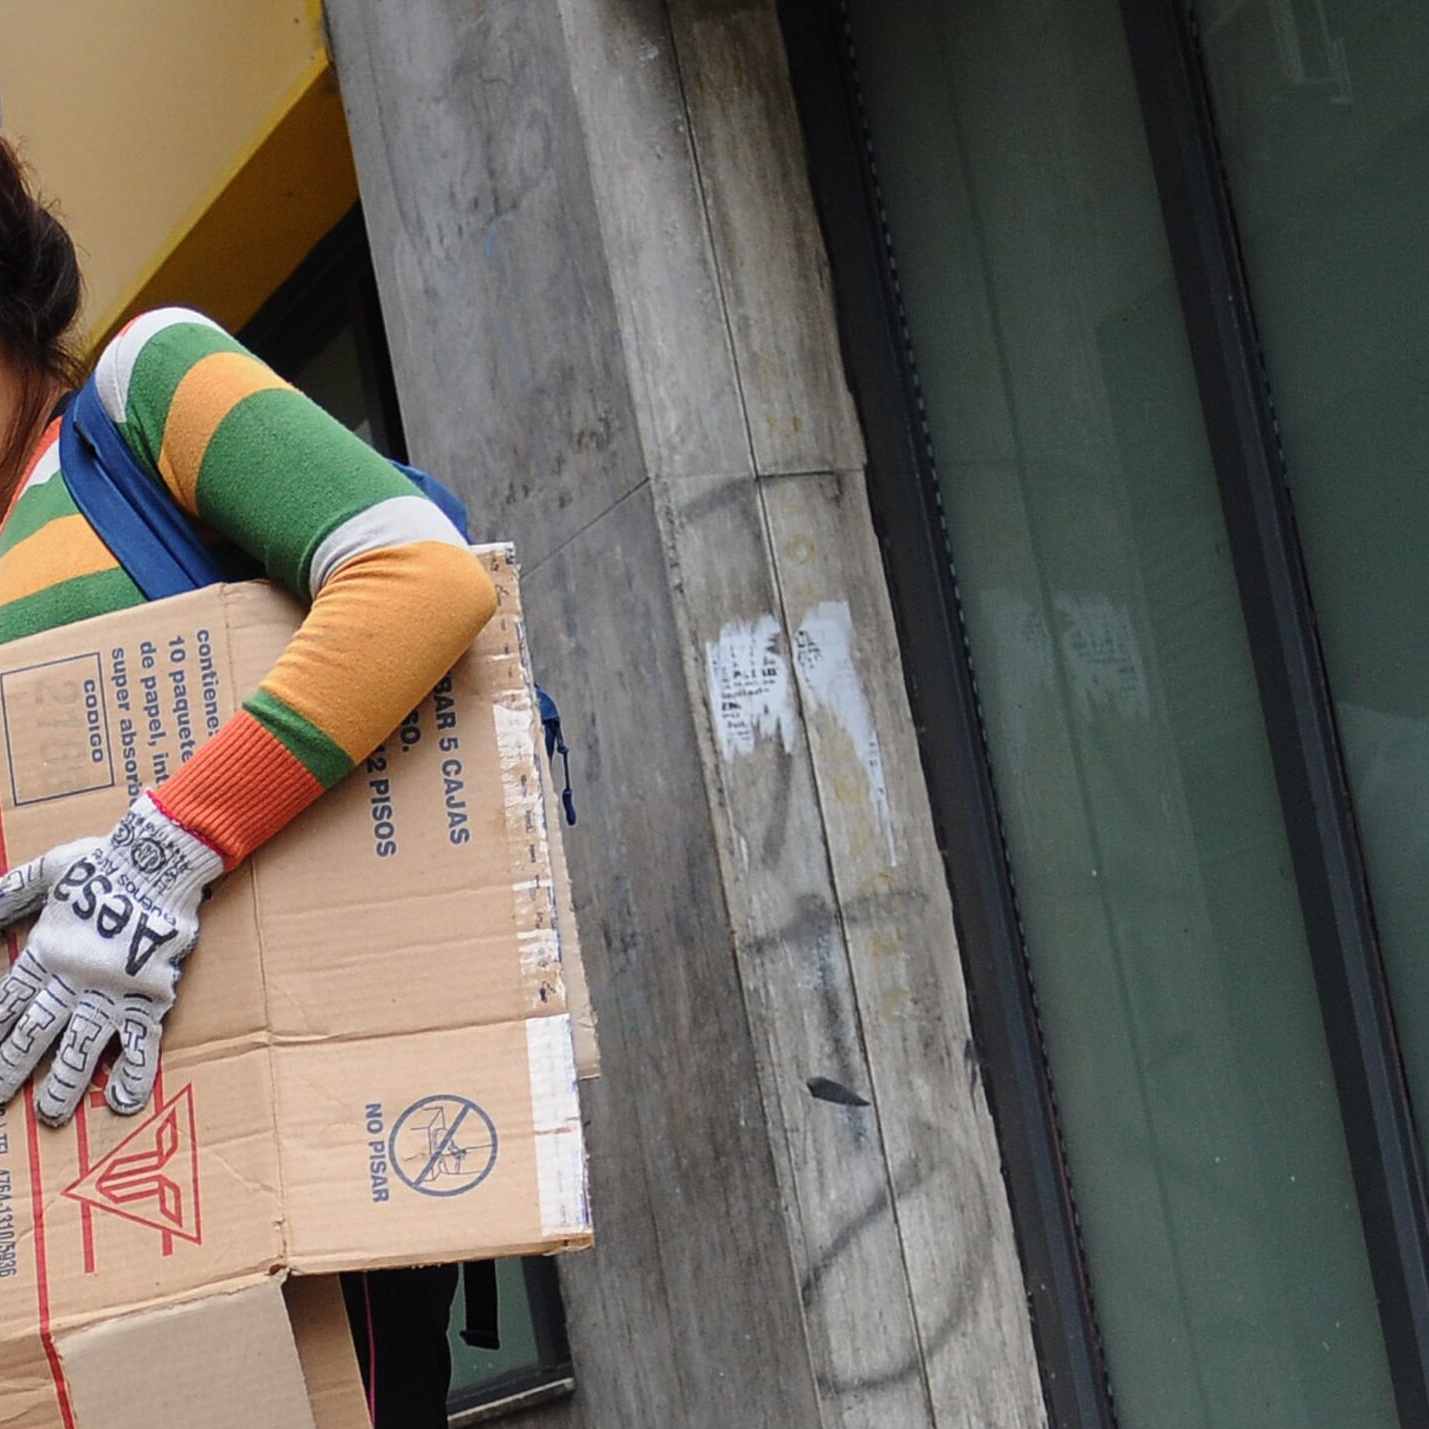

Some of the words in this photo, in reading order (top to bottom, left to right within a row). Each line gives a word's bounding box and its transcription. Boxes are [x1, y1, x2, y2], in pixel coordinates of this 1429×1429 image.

[111, 648, 131, 711] super
[140, 641, 157, 669] de
[168, 635, 186, 662] 10
[83, 679, 105, 763] CODIGO
[141, 675, 167, 747] papel,
[439, 737, 459, 752] 5
[120, 717, 142, 806] absorb
[369, 779, 397, 858] PISOS
[442, 759, 471, 845] CAJAS
[53, 857, 179, 977] Aesa
[365, 1103, 384, 1134] NO
[368, 1141, 389, 1203] PISAR
